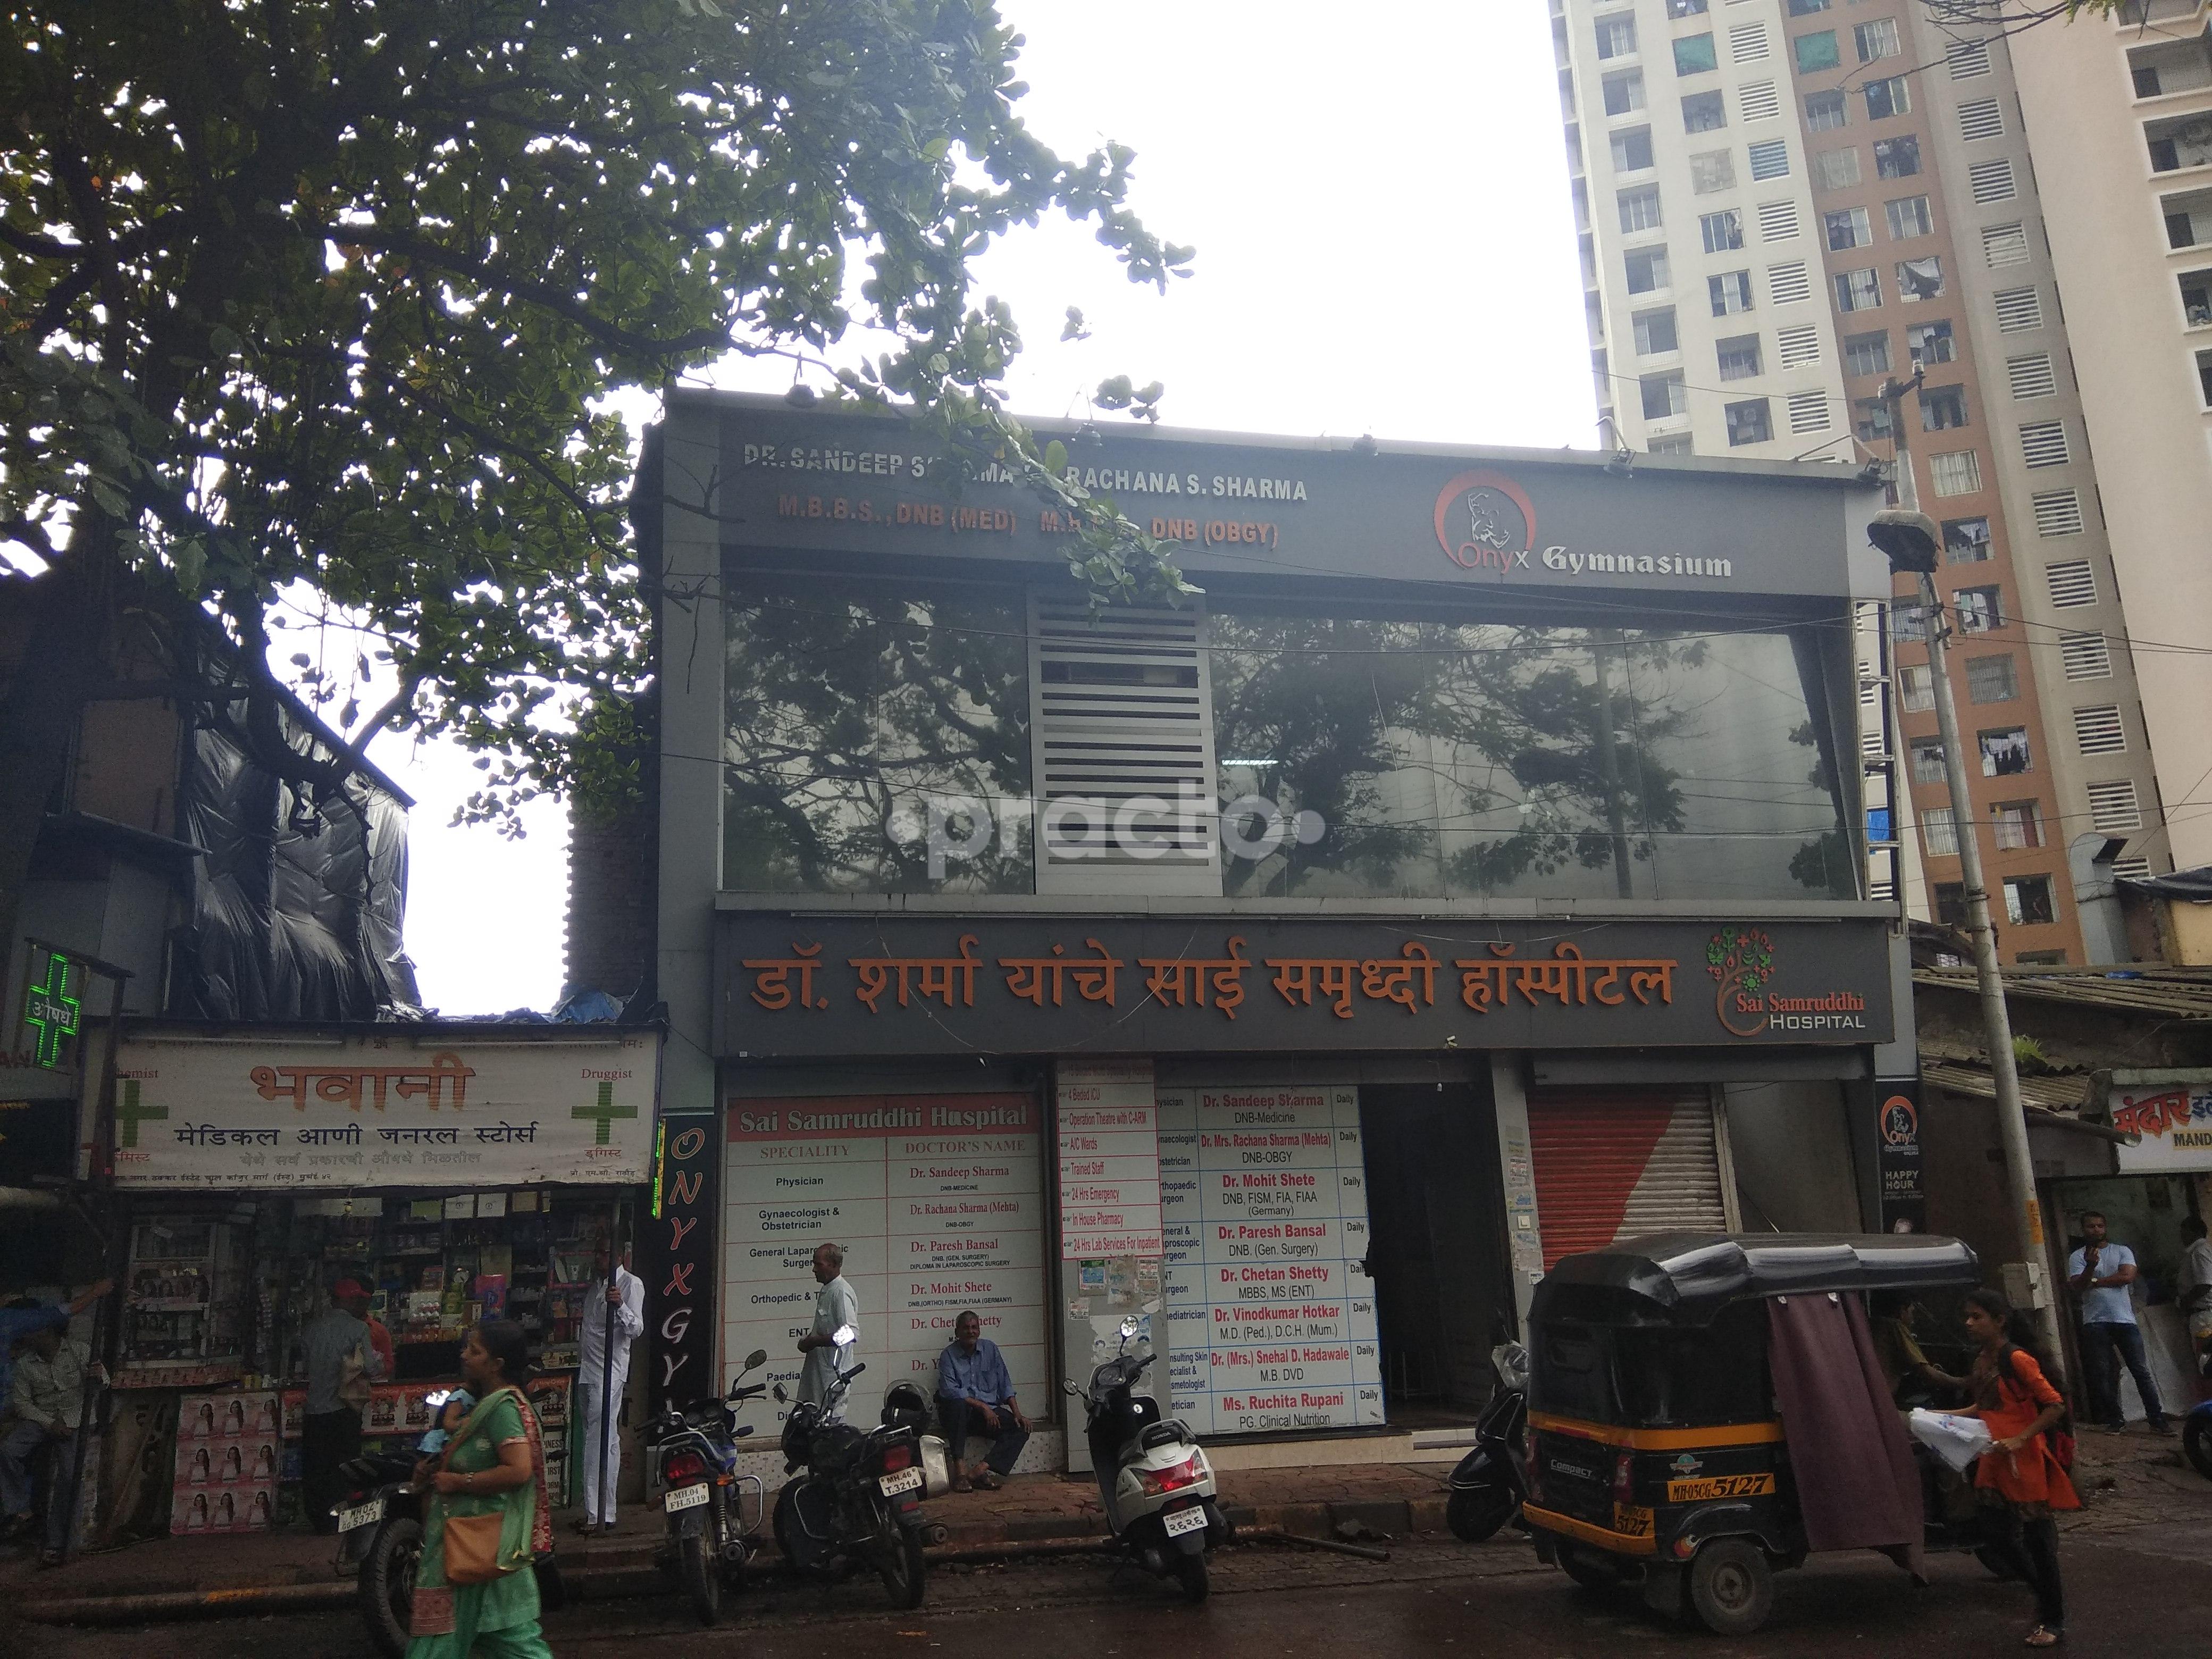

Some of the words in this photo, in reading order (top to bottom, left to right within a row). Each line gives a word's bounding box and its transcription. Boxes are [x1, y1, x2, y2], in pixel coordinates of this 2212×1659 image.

[744, 444, 785, 467] DR.
[791, 447, 903, 475] SANDEEP
[1067, 466, 1180, 493] RACHANA
[1187, 474, 1207, 495] S.
[1213, 476, 1308, 500] SHARMA
[896, 501, 944, 526] DNB
[951, 507, 1016, 533] (MED)
[1152, 518, 1198, 541] DNB
[1205, 520, 1278, 551] (OBGY)
[1458, 542, 1530, 574] Onyx
[1543, 546, 1731, 576] Gymnasium
[742, 941, 829, 1010] डॉ.
[848, 933, 983, 1015] शर्मा
[997, 937, 1124, 1008] यांचे
[1138, 936, 1253, 1020] साई
[1455, 941, 1679, 1013] हॉस्पीटल
[1736, 992, 1764, 1012] Sai
[1769, 991, 1865, 1012] Samruddhi
[1770, 1014, 1866, 1030] HOSPITAL
[250, 1052, 476, 1112] भवानी
[581, 1068, 632, 1081] Druggist
[1203, 1095, 1219, 1108] Dr.
[1223, 1094, 1276, 1110] Sandeep
[1278, 1093, 1324, 1106] Sharma
[1337, 1094, 1354, 1105] Daily
[740, 1111, 778, 1133] Sai
[787, 1107, 921, 1131] Samruddhi
[1069, 1112, 1095, 1128] Operation
[1096, 1112, 1116, 1125] Theatre
[1117, 1112, 1128, 1124] with
[1128, 1111, 1147, 1124] C-ARM
[1235, 1111, 1295, 1124] DNB-Medicine
[174, 1122, 280, 1146] मेडिकल
[297, 1123, 363, 1145] आणी
[377, 1127, 459, 1144] जनरल
[473, 1120, 539, 1144] स्टोर्स
[1201, 1135, 1212, 1147] Dr.
[1214, 1134, 1231, 1147] Mrs.
[1234, 1134, 1268, 1146] Rachana
[1270, 1133, 1299, 1145] Sharma
[1302, 1132, 1331, 1149] (Mehta)
[1339, 1132, 1357, 1143] Daily
[906, 1141, 980, 1153] DOCTOR'S
[983, 1140, 1026, 1152] NAME
[1080, 1137, 1097, 1150] Wards
[760, 1145, 849, 1159] SPECIALITY
[1242, 1151, 1292, 1164] DNB-OBGY
[910, 1168, 926, 1178] Dr.
[929, 1167, 969, 1179] Sandeep
[973, 1166, 1009, 1176] Sharma
[1071, 1162, 1090, 1175] Trained
[1092, 1161, 1104, 1174] Staff
[1886, 1170, 1918, 1180] HAPPY
[776, 1176, 824, 1188] Physician
[1223, 1175, 1239, 1188] Dr.
[1243, 1174, 1277, 1187] Mohit
[1280, 1174, 1316, 1186] Shete
[1343, 1177, 1361, 1188] Daily
[1886, 1180, 1914, 1189] HOUR
[1079, 1187, 1089, 1200] Hrs
[1091, 1187, 1119, 1203] Emergency
[1223, 1193, 1245, 1206] DNB,
[1248, 1192, 1273, 1205] FISM,
[1276, 1192, 1293, 1204] FIA,
[1296, 1191, 1317, 1203] FIAA
[663, 1127, 706, 1296] ONYX
[759, 1208, 830, 1220] Gynaecologist
[833, 1207, 840, 1216] &
[910, 1204, 923, 1215] Dr.
[925, 1203, 957, 1214] Rachana
[959, 1202, 987, 1213] Sharma
[990, 1201, 1019, 1214] (Mehta)
[1249, 1206, 1294, 1217] (Germany)
[761, 1220, 822, 1230] Obstetrician
[1079, 1212, 1096, 1226] House
[1097, 1212, 1124, 1227] Pharmacy
[1219, 1226, 1235, 1239] Dr.
[1239, 1225, 1281, 1238] Paresh
[1285, 1224, 1326, 1237] Bansal
[1347, 1222, 1364, 1233] Daily
[750, 1247, 785, 1257] General
[911, 1242, 927, 1252] Dr.
[930, 1240, 962, 1251] Paresh
[966, 1238, 998, 1250] Bansal
[1082, 1238, 1090, 1251] Hrs
[1092, 1237, 1102, 1251] Lab
[1103, 1237, 1126, 1250] Services
[1127, 1236, 1136, 1250] For
[1137, 1236, 1160, 1252] Inpatient
[1229, 1245, 1252, 1256] DNB.
[1254, 1244, 1279, 1259] (Gen.
[1281, 1242, 1318, 1258] Surgery)
[1221, 1269, 1237, 1282] Dr.
[1242, 1267, 1287, 1281] Chetan
[1289, 1266, 1328, 1283] Shetty
[910, 1284, 927, 1295] Dr.
[931, 1283, 961, 1294] Mohit
[965, 1281, 992, 1293] Shete
[1239, 1286, 1269, 1300] MBBS,
[1271, 1285, 1286, 1298] MS
[1288, 1284, 1314, 1300] (ENT)
[751, 1293, 802, 1304] Orthopedic
[1214, 1308, 1230, 1322] Dr.
[1233, 1306, 1299, 1321] Vinodkumar
[1303, 1305, 1339, 1319] Hotkar
[1353, 1303, 1371, 1314] Daily
[911, 1318, 927, 1329] Dr.
[789, 1328, 810, 1337] ENT
[1220, 1327, 1241, 1340] M.D.
[1243, 1326, 1273, 1341] (Ped.),
[1276, 1324, 1304, 1337] D.C.H.
[1307, 1323, 1338, 1338] (Mum.)
[1211, 1352, 1225, 1365] Dr.
[1227, 1351, 1254, 1369] (Mrs.)
[1256, 1350, 1288, 1364] Snehal
[1291, 1350, 1301, 1363] D.
[1303, 1347, 1350, 1362] Hadawale
[1356, 1345, 1375, 1356] Daily
[1260, 1369, 1280, 1382] M.B.
[1283, 1368, 1304, 1381] DVD
[1223, 1397, 1245, 1411] Ms.
[1249, 1394, 1297, 1410] Ruchita
[1301, 1391, 1344, 1410] Rupani
[1360, 1390, 1378, 1401] Daily
[1239, 1415, 1257, 1429] PG.
[1259, 1414, 1292, 1427] Clinical
[1294, 1412, 1330, 1426] Nutrition
[1151, 1431, 1171, 1440] HONDA
[886, 1471, 912, 1484] MH.46
[674, 1487, 699, 1500] MH.04
[885, 1478, 918, 1494] T.3214
[1711, 1475, 1771, 1497] 5127
[670, 1494, 706, 1510] FH.5119
